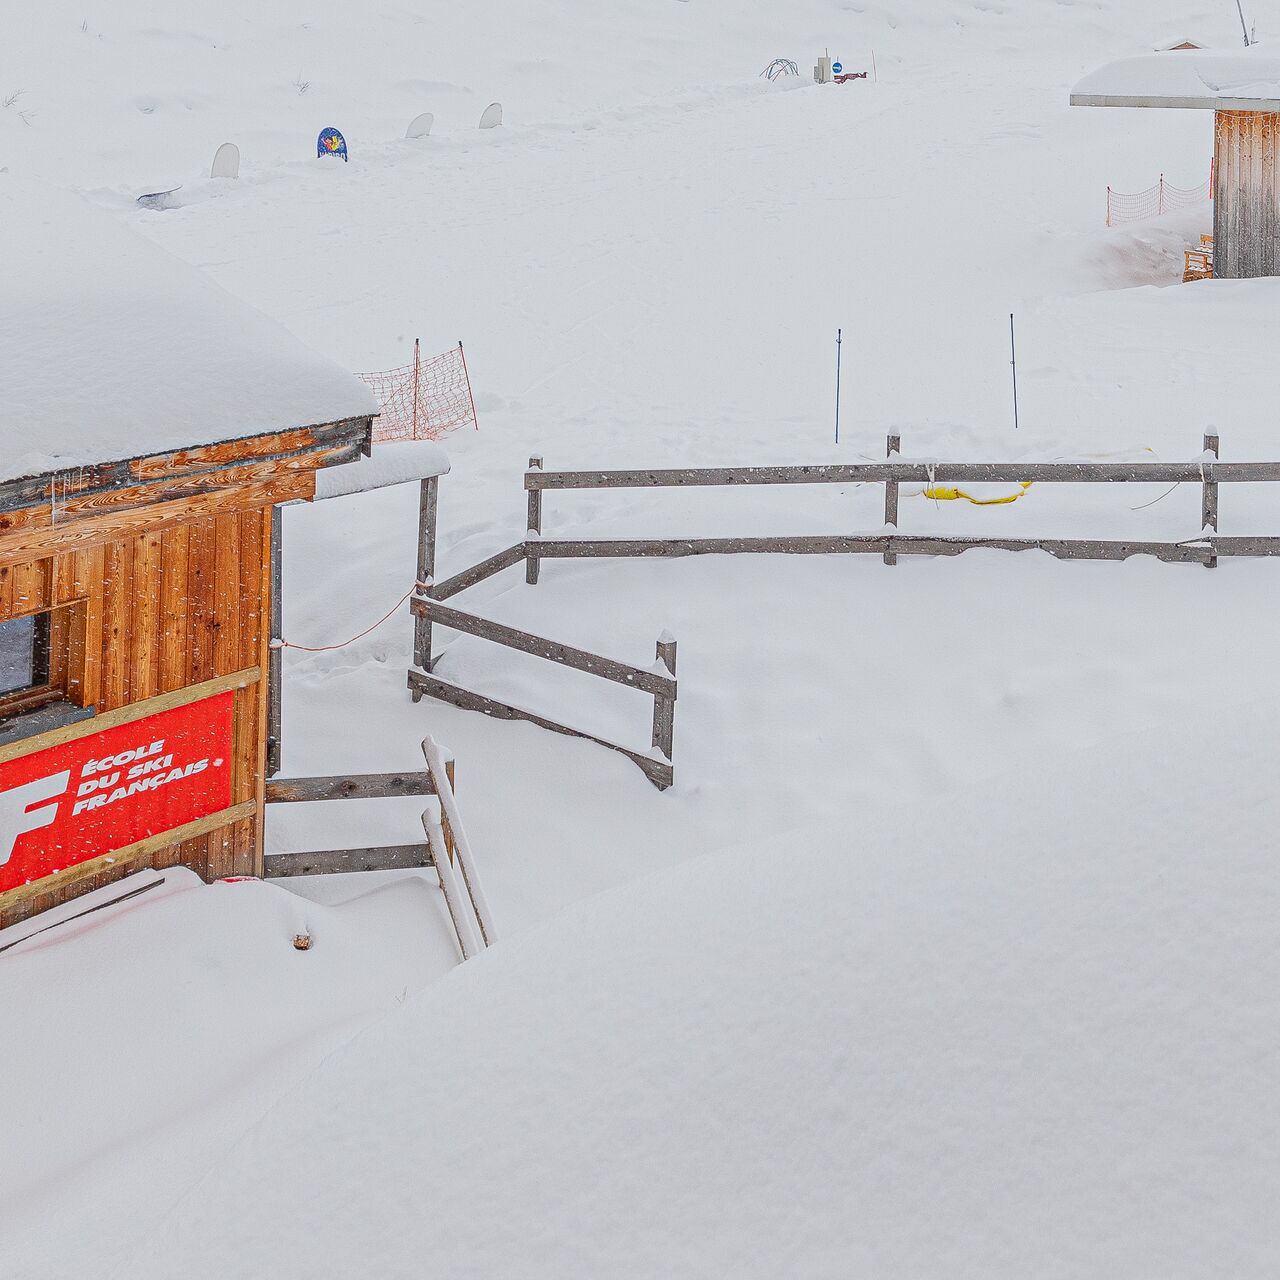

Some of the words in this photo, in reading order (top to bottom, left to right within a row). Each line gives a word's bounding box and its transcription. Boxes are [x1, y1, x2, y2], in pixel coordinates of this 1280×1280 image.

[76, 771, 121, 798] DU
[126, 753, 174, 780] SKI
[81, 739, 165, 778] ÉCOLE
[71, 758, 210, 817] FRANÇAIS
